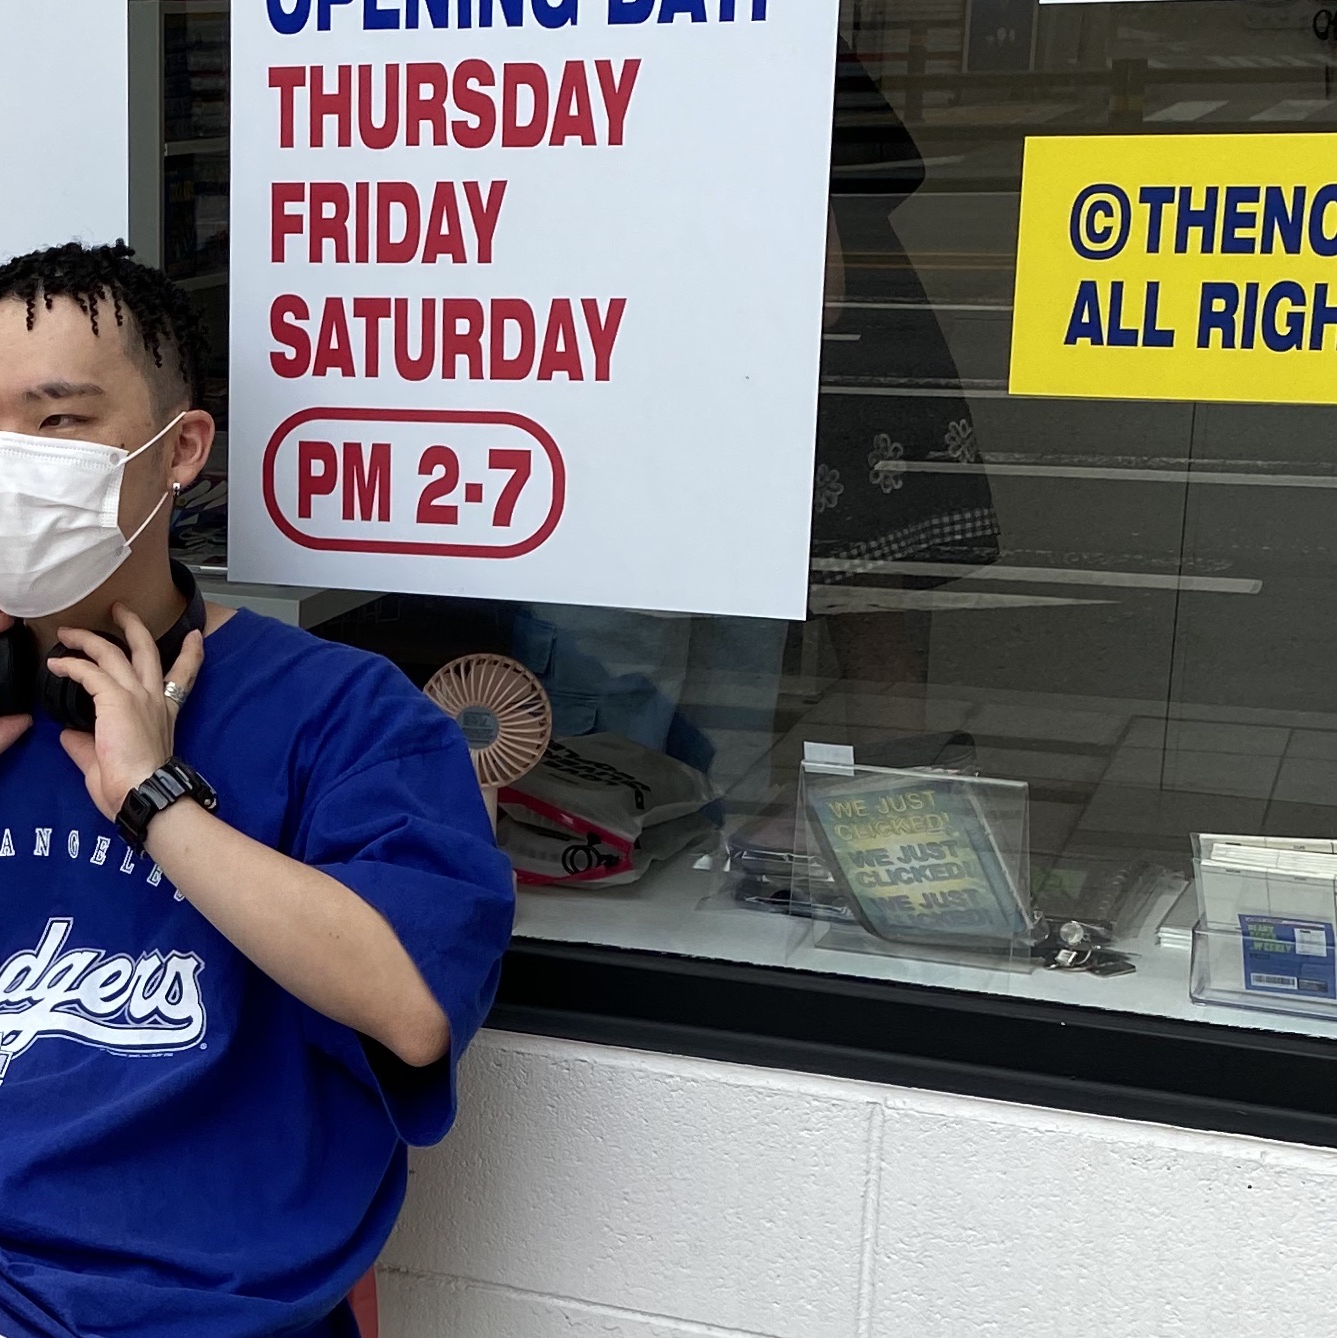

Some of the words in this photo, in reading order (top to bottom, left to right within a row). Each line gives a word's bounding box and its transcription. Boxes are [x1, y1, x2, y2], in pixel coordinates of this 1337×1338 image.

[267, 58, 642, 150] THURSDAY
[269, 179, 508, 265] FRIDAY
[268, 293, 628, 383] SATURDAY
[1063, 280, 1176, 348] ALL
[1196, 280, 1337, 353] RIGH
[296, 438, 393, 523] PM
[415, 444, 533, 528] 2-7
[827, 799, 870, 820] WE
[876, 790, 937, 815] JUST
[848, 848, 894, 869] WE
[896, 840, 959, 864] JUST
